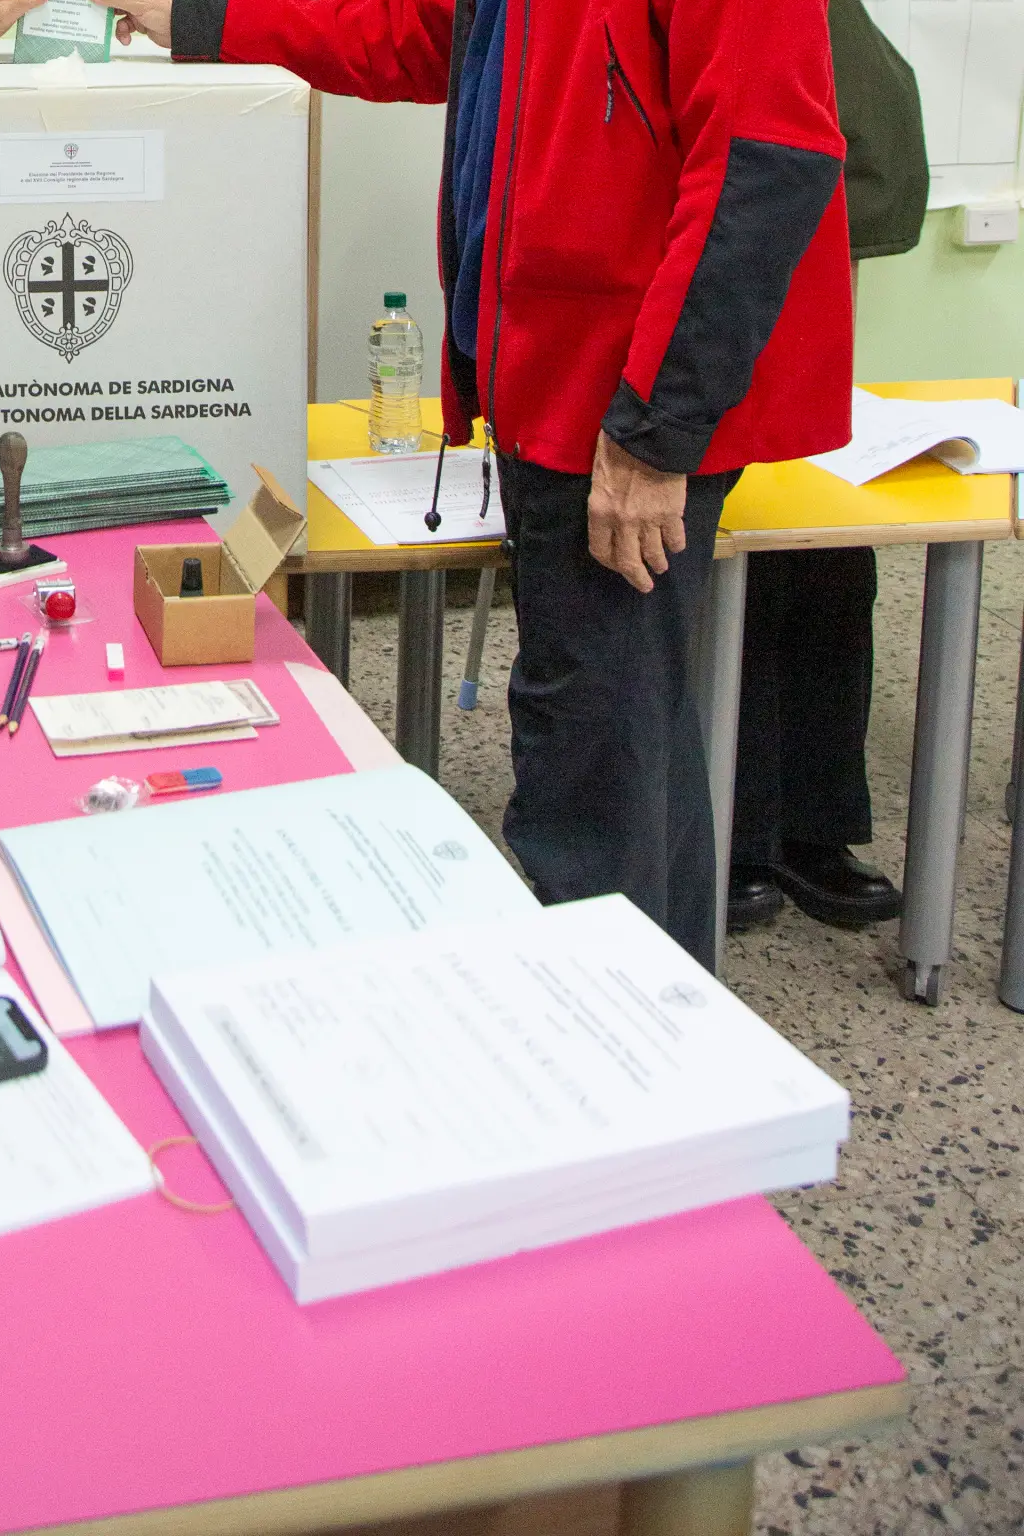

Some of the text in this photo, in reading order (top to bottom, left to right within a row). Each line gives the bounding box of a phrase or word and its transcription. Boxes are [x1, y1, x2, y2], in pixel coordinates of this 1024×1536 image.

[108, 381, 132, 395] DE
[137, 378, 235, 395] SARDIGNA
[91, 405, 146, 421] DELLA
[151, 402, 253, 419] SARDEGNA
